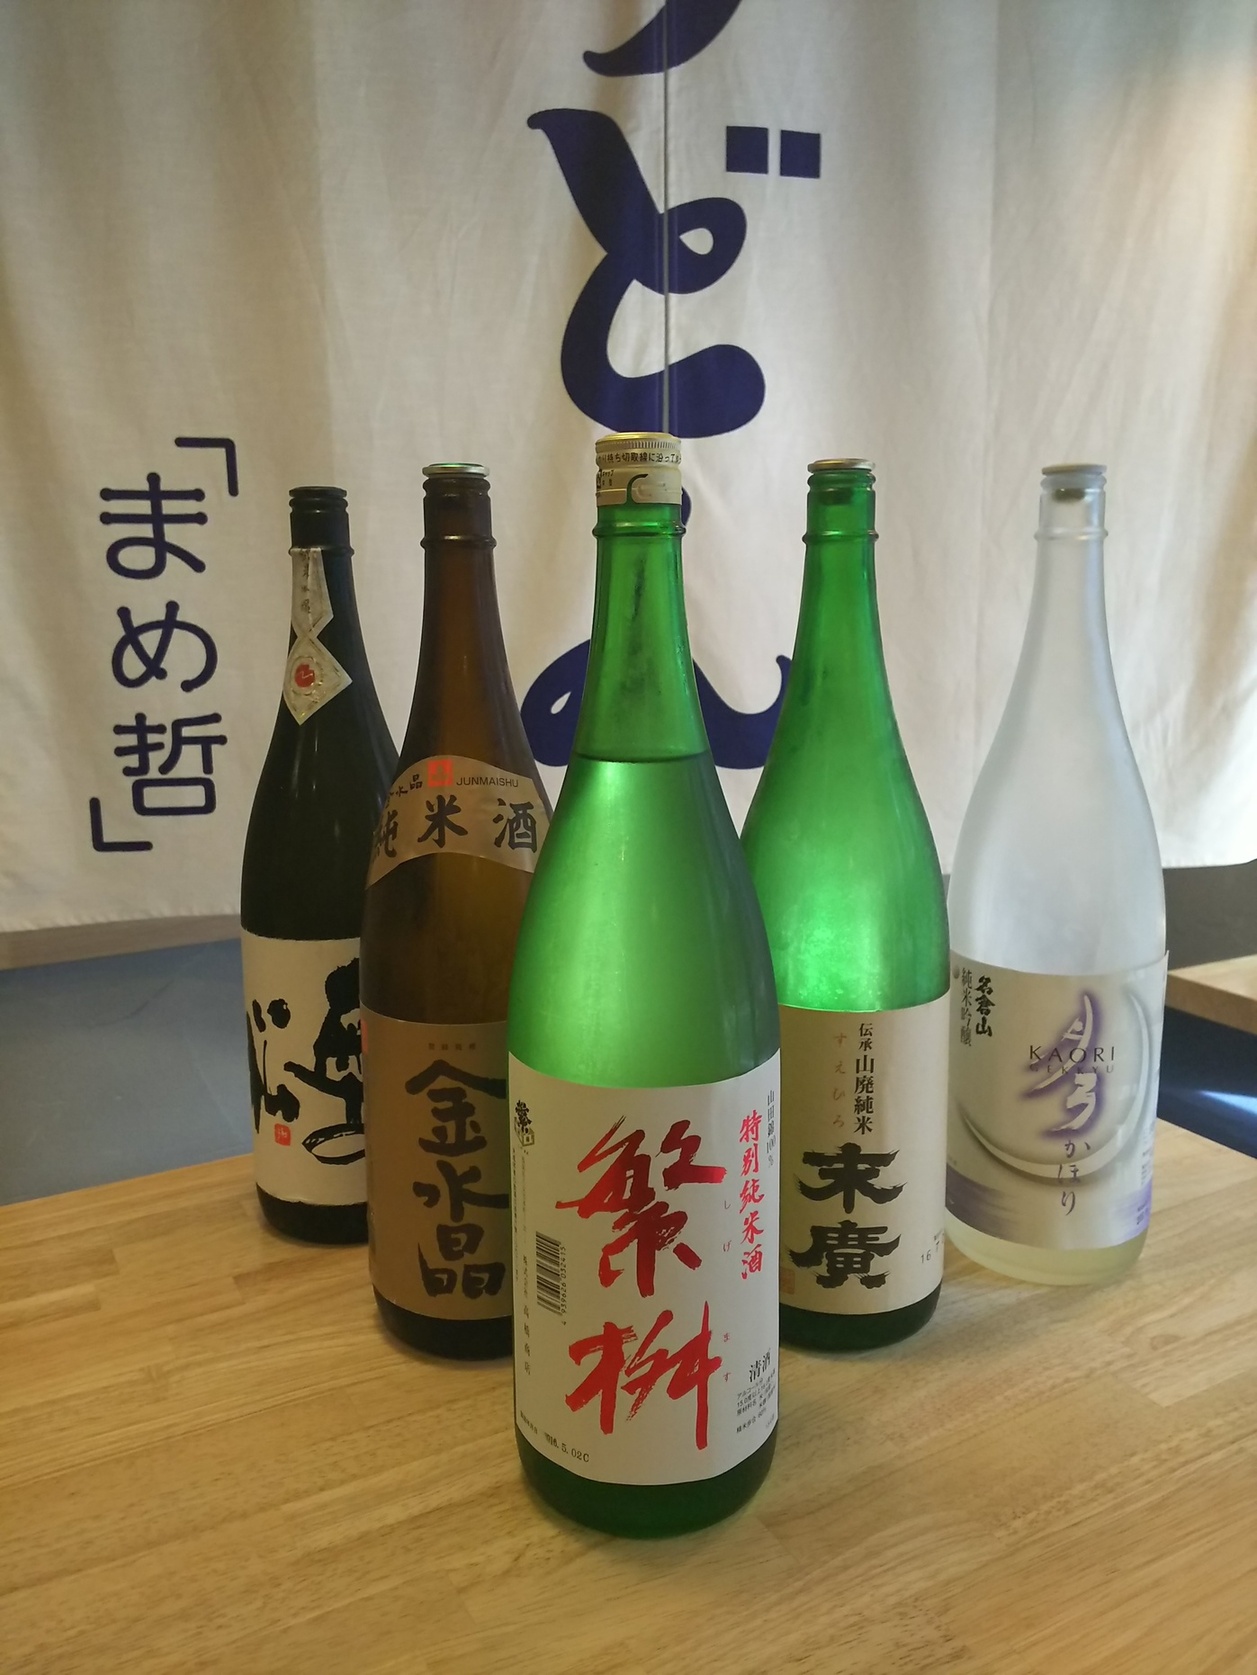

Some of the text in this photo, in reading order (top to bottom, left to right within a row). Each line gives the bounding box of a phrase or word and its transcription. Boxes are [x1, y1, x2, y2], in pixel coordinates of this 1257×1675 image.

[89, 436, 240, 853] 「まめ哲」
[456, 776, 519, 788] JUNMAISHU
[373, 794, 539, 859] 純米酒
[974, 974, 996, 1038] 名倉山
[832, 1031, 848, 1130] すえひろ
[853, 1022, 875, 1136] 伝承山廃純米
[1029, 1044, 1116, 1064] KAORI
[404, 1059, 511, 1300] 金水晶
[738, 1109, 766, 1280] 特別純米酒
[1056, 1139, 1092, 1217] かほり
